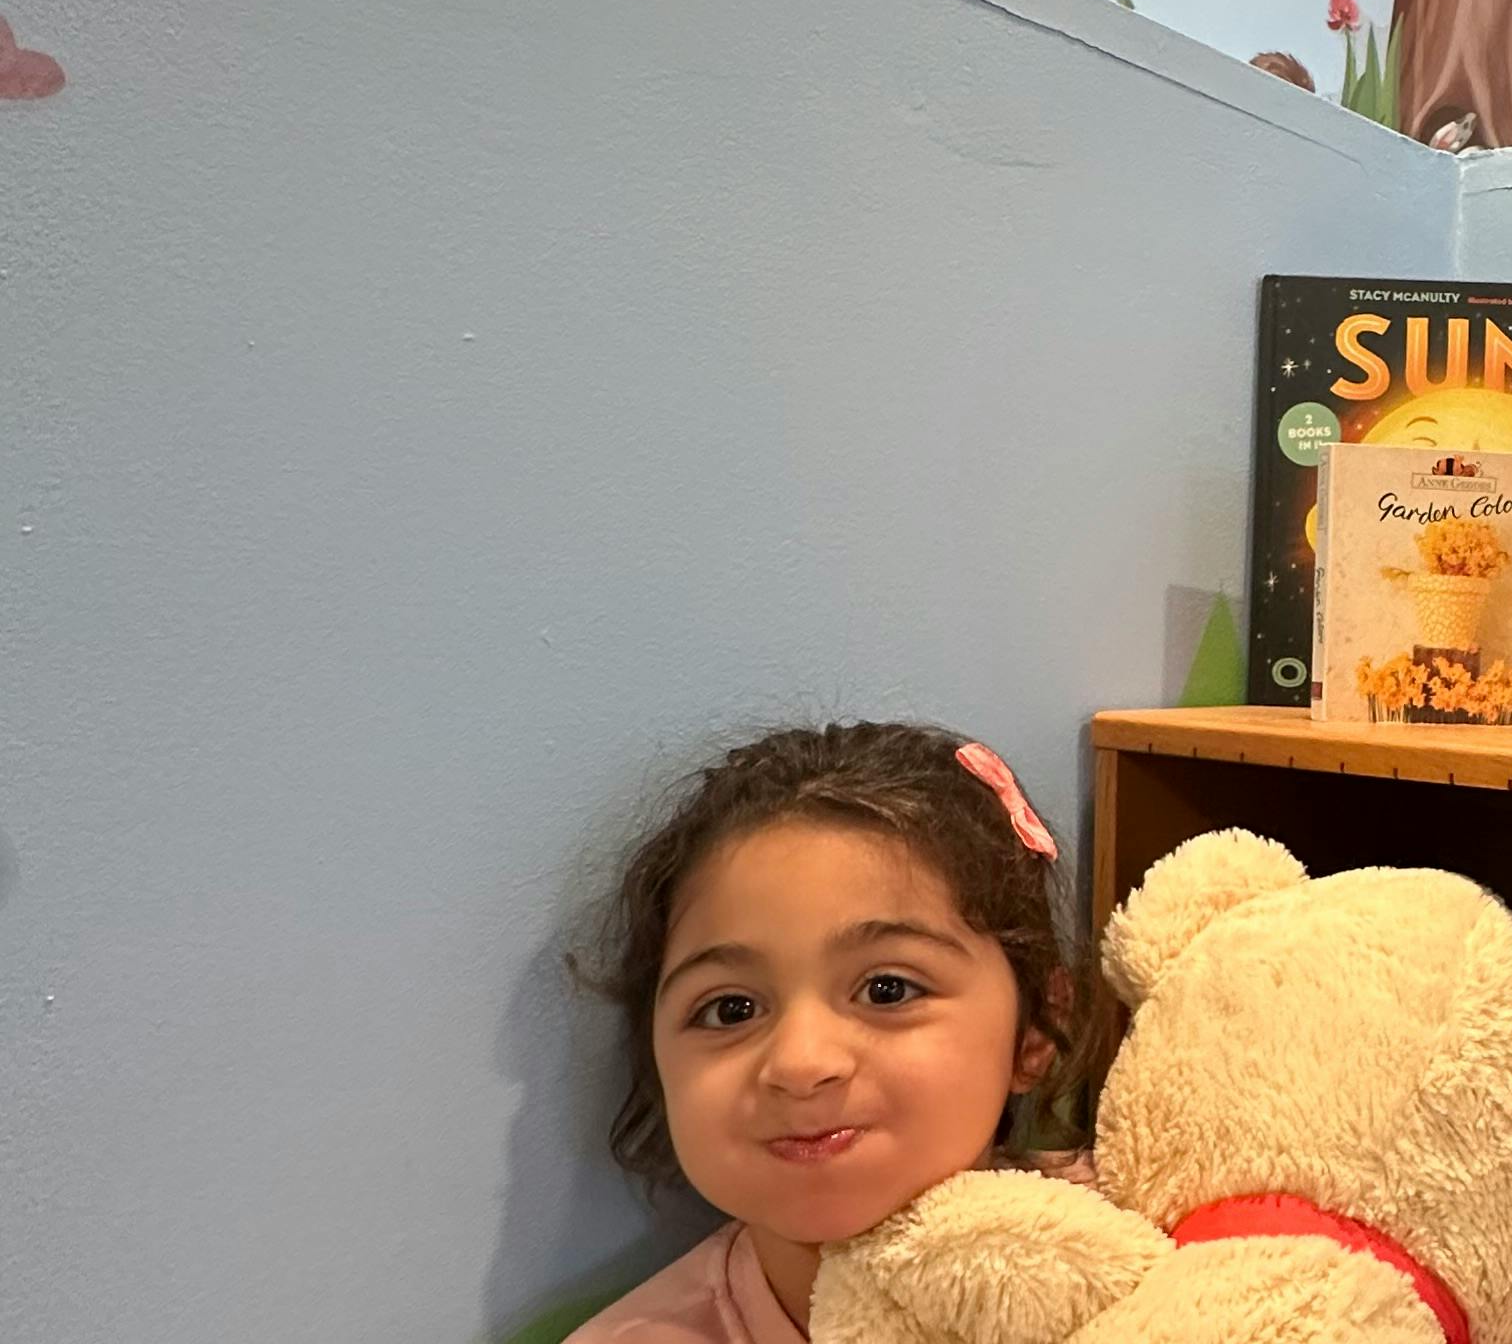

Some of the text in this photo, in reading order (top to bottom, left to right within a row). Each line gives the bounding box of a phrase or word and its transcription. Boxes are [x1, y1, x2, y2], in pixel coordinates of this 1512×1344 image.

[1350, 289, 1391, 302] STACY
[1304, 414, 1313, 425] 2
[1288, 426, 1332, 439] BOOKS
[1378, 492, 1460, 525] Garden
